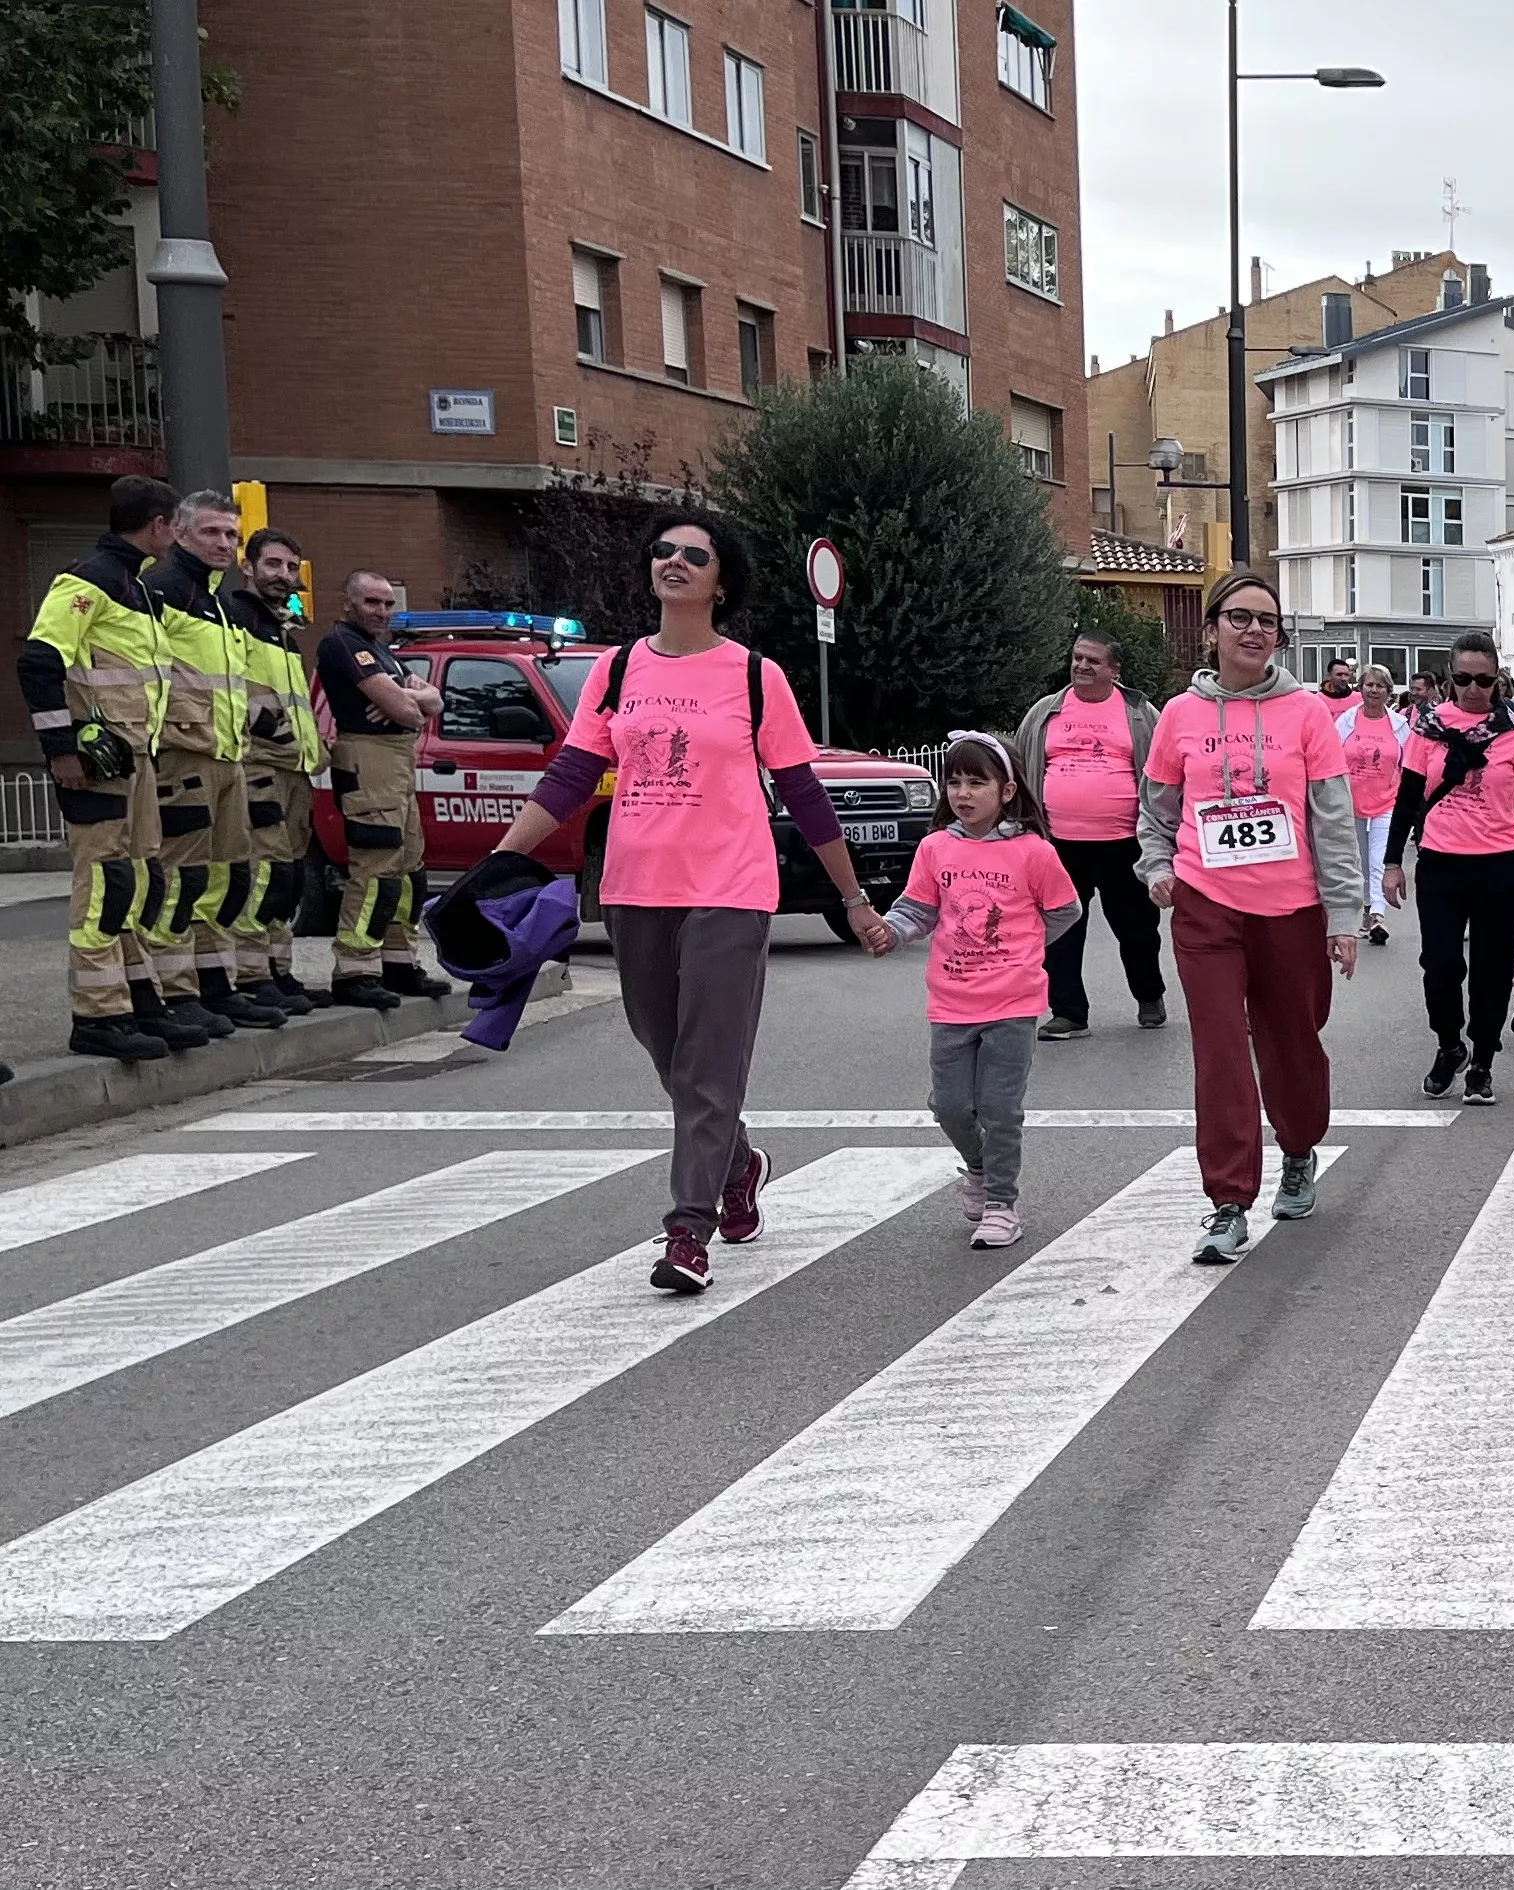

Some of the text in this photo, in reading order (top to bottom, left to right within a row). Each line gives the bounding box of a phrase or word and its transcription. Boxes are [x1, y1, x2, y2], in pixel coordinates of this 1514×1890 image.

[1206, 812, 1239, 823] CONTRA
[1250, 807, 1282, 818] CÁNCER
[1218, 820, 1276, 849] 483
